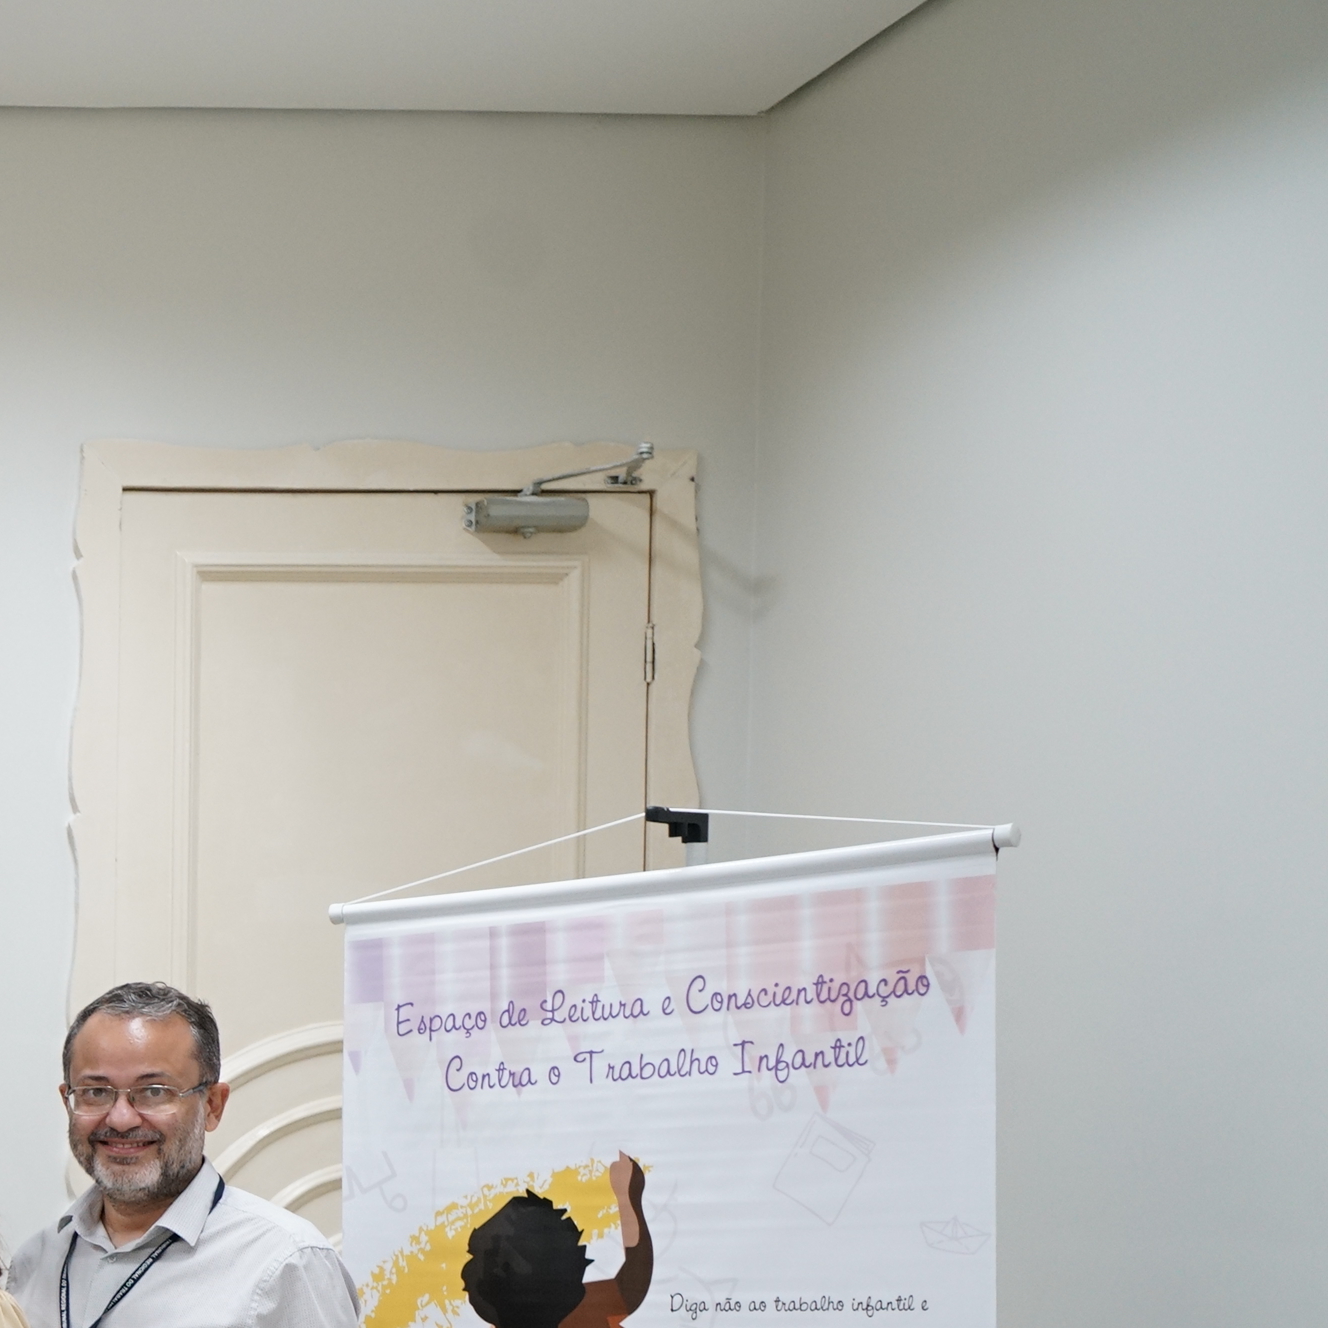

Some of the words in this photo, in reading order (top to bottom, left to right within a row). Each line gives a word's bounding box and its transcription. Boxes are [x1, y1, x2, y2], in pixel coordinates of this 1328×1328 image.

[395, 1002, 487, 1041] Espaço
[499, 1000, 529, 1028] de
[540, 989, 650, 1027] Leitura
[661, 995, 675, 1016] e
[685, 968, 931, 1016] Conscientização
[445, 1056, 537, 1092] Contra
[548, 1067, 561, 1085] o
[574, 1048, 719, 1085] Trabalho
[732, 1036, 869, 1084] Infantil
[670, 1292, 709, 1320] Diga
[715, 1298, 742, 1312] não
[748, 1300, 767, 1312] ao
[774, 1295, 845, 1312] trabalho
[851, 1294, 915, 1318] infantil
[921, 1300, 929, 1312] e
